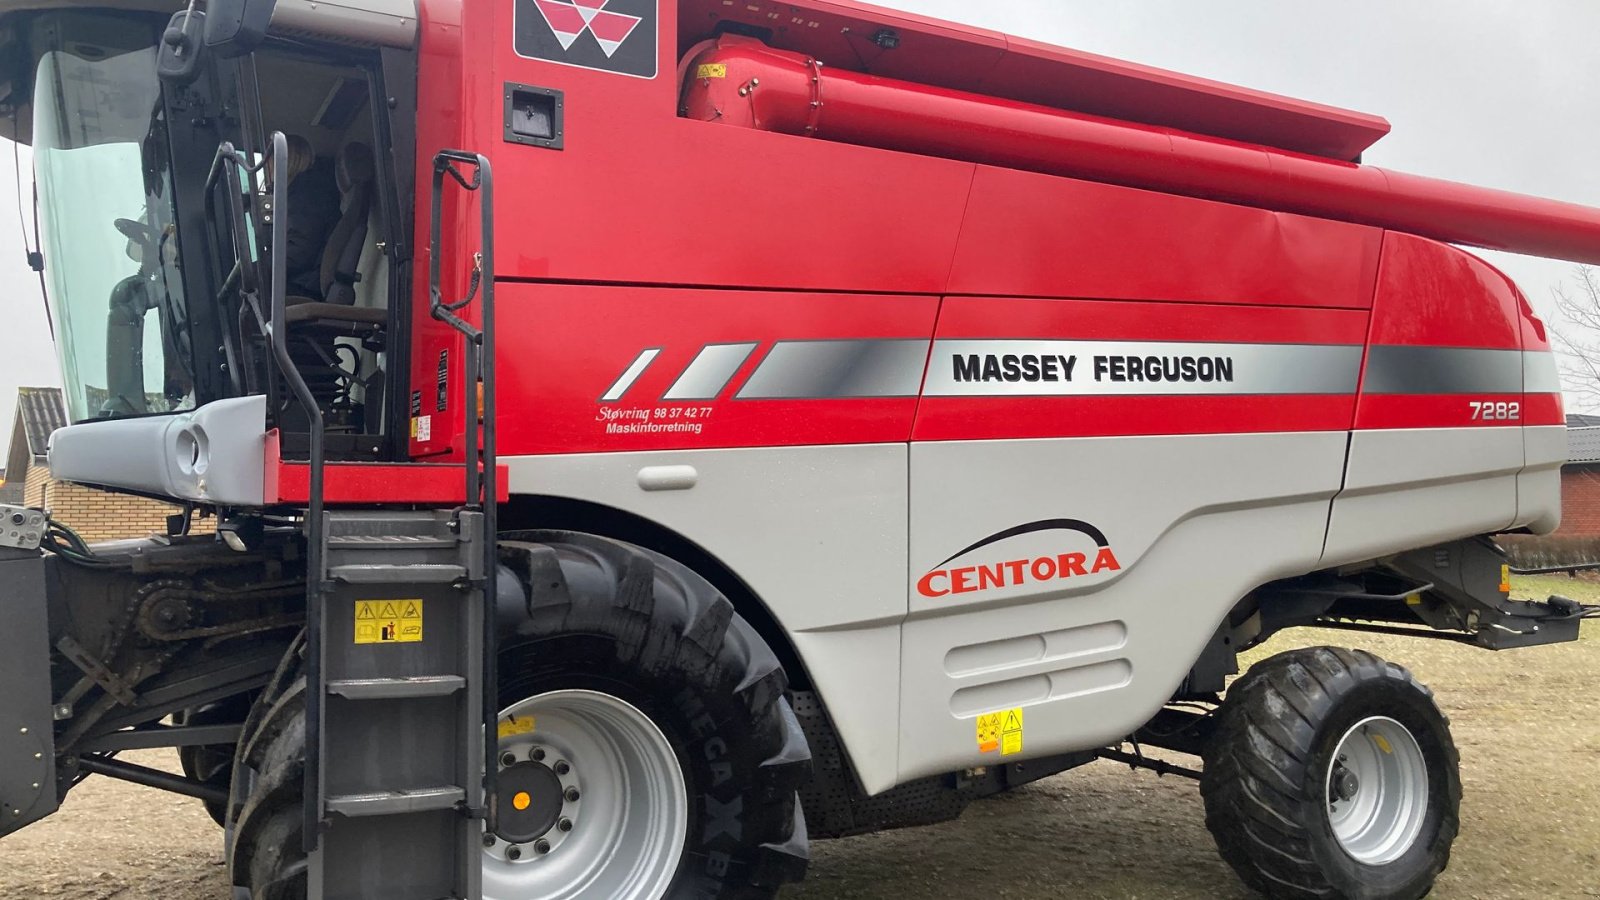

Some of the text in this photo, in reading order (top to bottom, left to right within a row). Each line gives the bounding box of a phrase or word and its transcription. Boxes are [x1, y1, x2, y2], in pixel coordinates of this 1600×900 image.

[952, 354, 1234, 382] MASSEY FERGUSON
[595, 406, 713, 423] Støvring 98 37 42 77
[1469, 401, 1520, 420] 7282
[606, 421, 702, 434] Maskinforretning
[917, 548, 1122, 597] CENTORA
